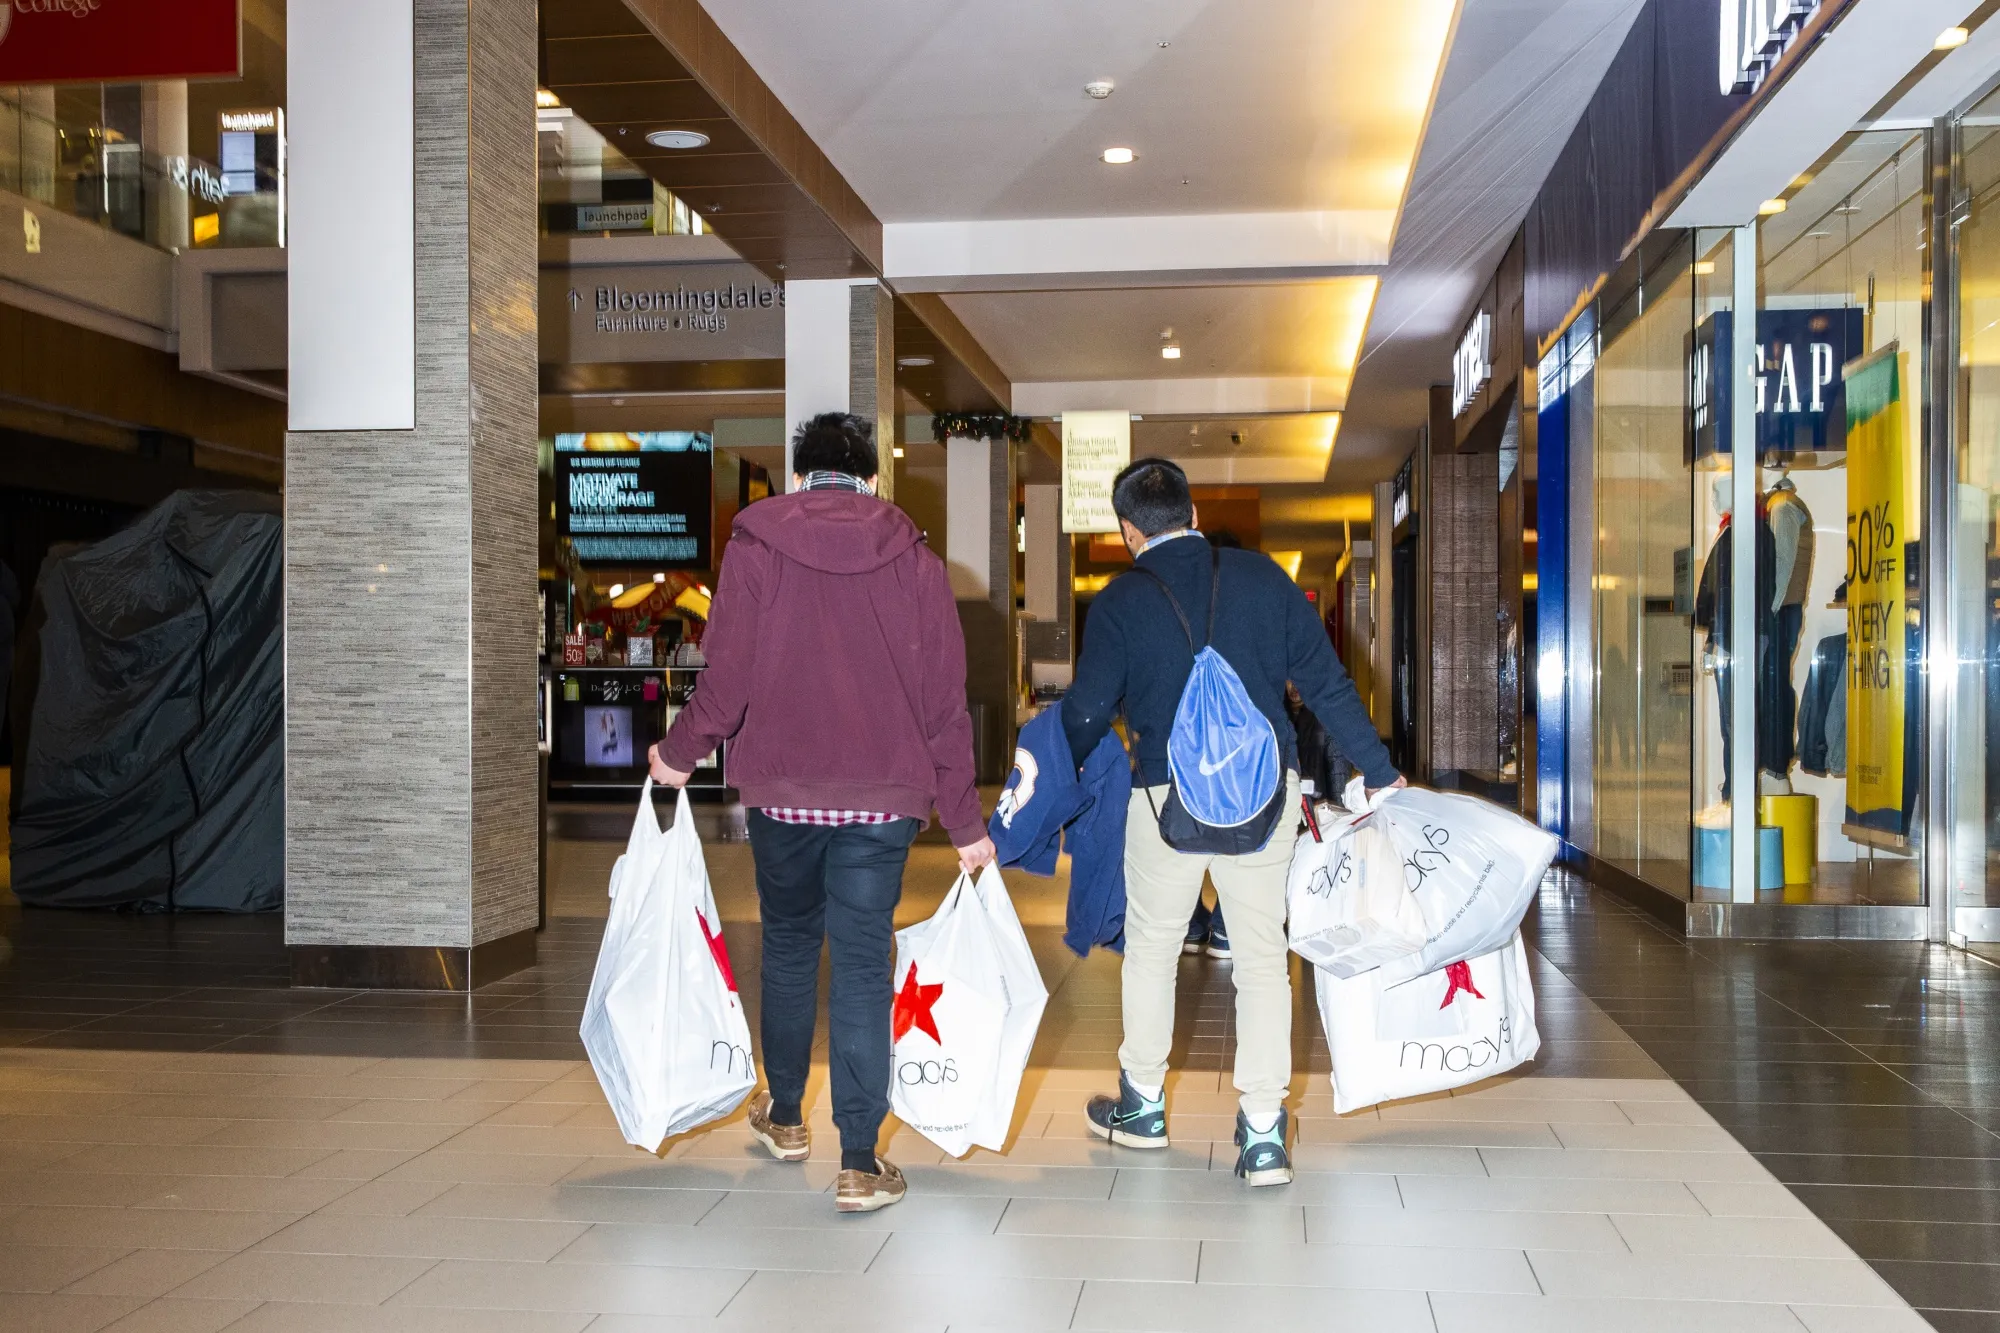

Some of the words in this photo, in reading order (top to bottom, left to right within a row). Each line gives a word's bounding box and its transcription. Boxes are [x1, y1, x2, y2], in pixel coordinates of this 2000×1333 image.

[584, 209, 648, 222] launchpad
[596, 313, 669, 333] Furniture
[687, 312, 727, 333] Rugs
[1873, 558, 1897, 584] OFF
[1847, 601, 1894, 645] VERY
[565, 635, 584, 646] SALE!
[1455, 906, 1466, 919] and
[1464, 884, 1482, 908] recycle
[1399, 1016, 1512, 1073] macy's
